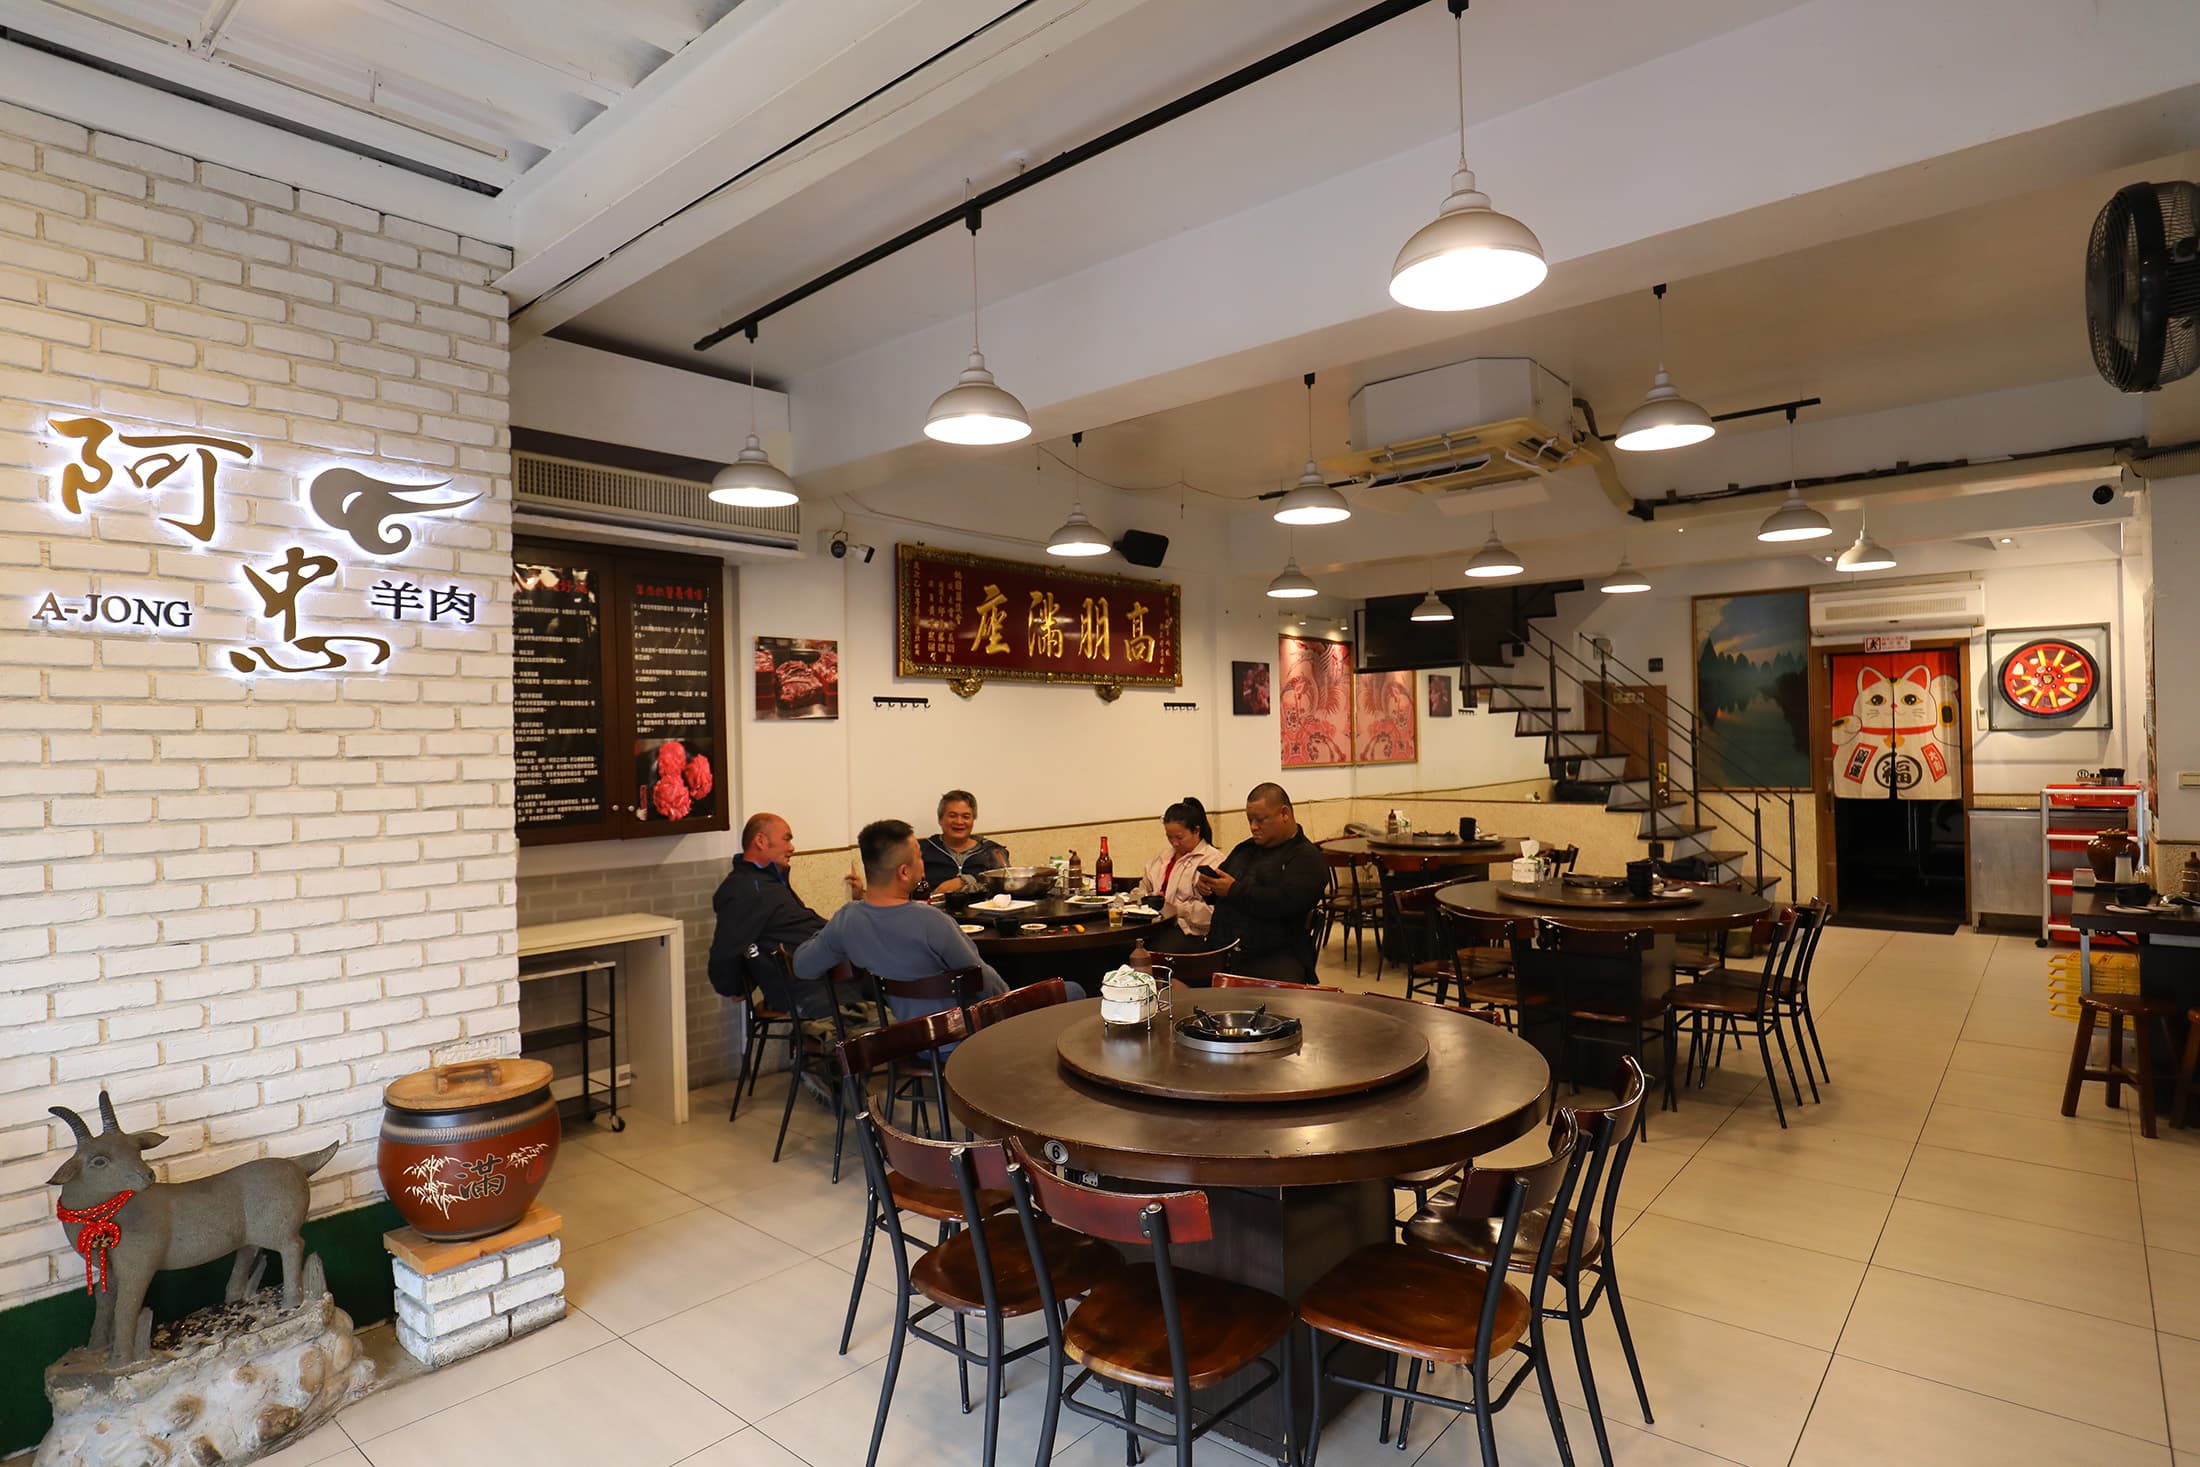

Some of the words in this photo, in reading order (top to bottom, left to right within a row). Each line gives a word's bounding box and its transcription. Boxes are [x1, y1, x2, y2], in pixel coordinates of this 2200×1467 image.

[48, 417, 254, 542] 阿
[32, 591, 193, 628] A-JONG
[229, 547, 391, 673] 忠
[371, 579, 477, 624] 羊肉
[1881, 759, 1913, 785] 福
[1052, 1144, 1061, 1160] 6
